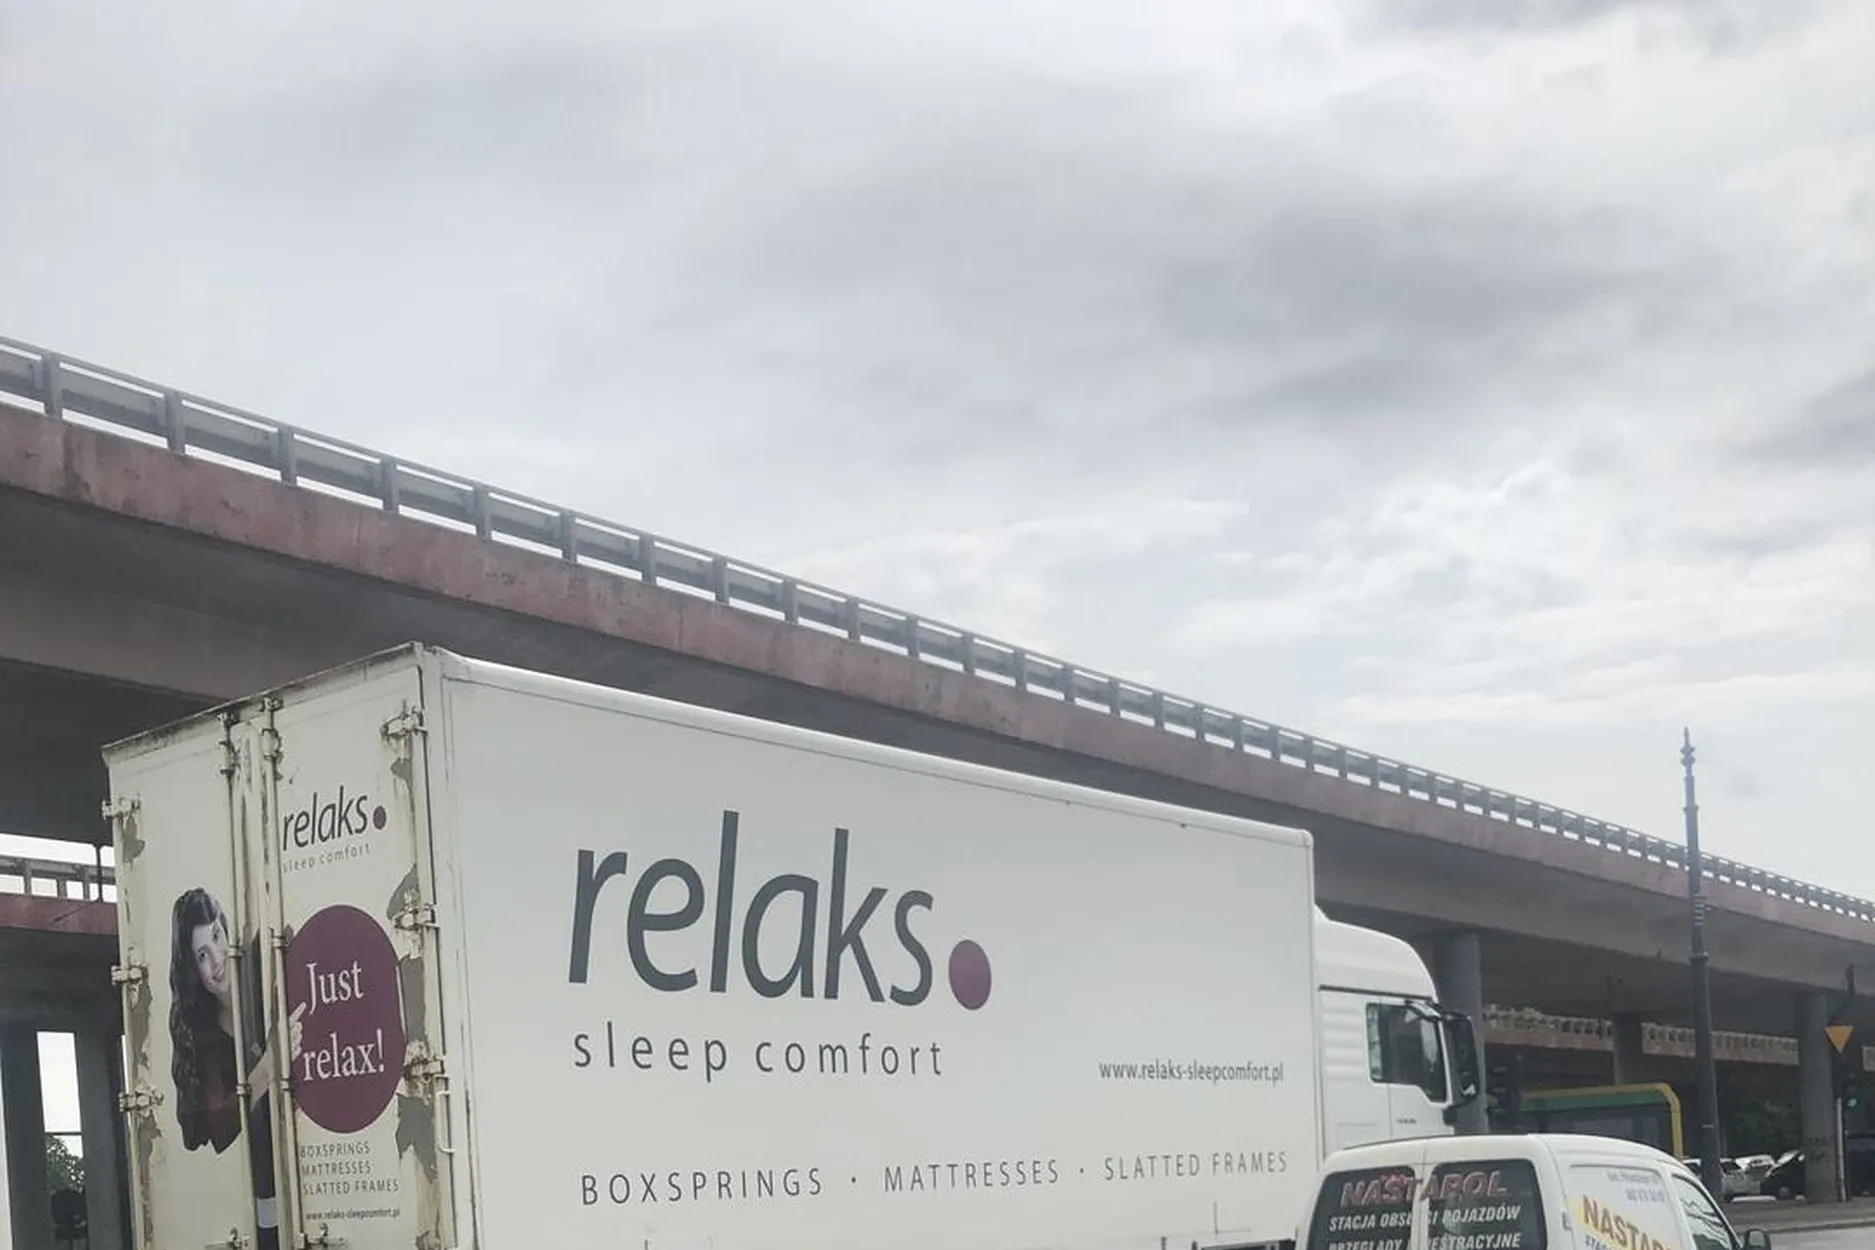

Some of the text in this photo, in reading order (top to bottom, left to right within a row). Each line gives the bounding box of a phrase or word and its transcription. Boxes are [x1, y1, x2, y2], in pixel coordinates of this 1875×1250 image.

[320, 844, 370, 864] comfort
[306, 960, 364, 1015] Just
[303, 1028, 385, 1081] relax!
[573, 1021, 942, 1082] sleep comfort
[1099, 1058, 1285, 1084] www.relaks-sleepcomfort.pl
[300, 1141, 371, 1158] BOXSPRINGS
[301, 1161, 372, 1176] MATTRESSES
[581, 1151, 1288, 1206] BOXSPRINGS MATTRESSES SLATTED FRAMES
[303, 1179, 399, 1195] SLATTED FRAMES
[1340, 1171, 1508, 1208] NASTAPOL
[1328, 1213, 1376, 1232] STACJA
[1442, 1202, 1522, 1223] POJAZDÓW
